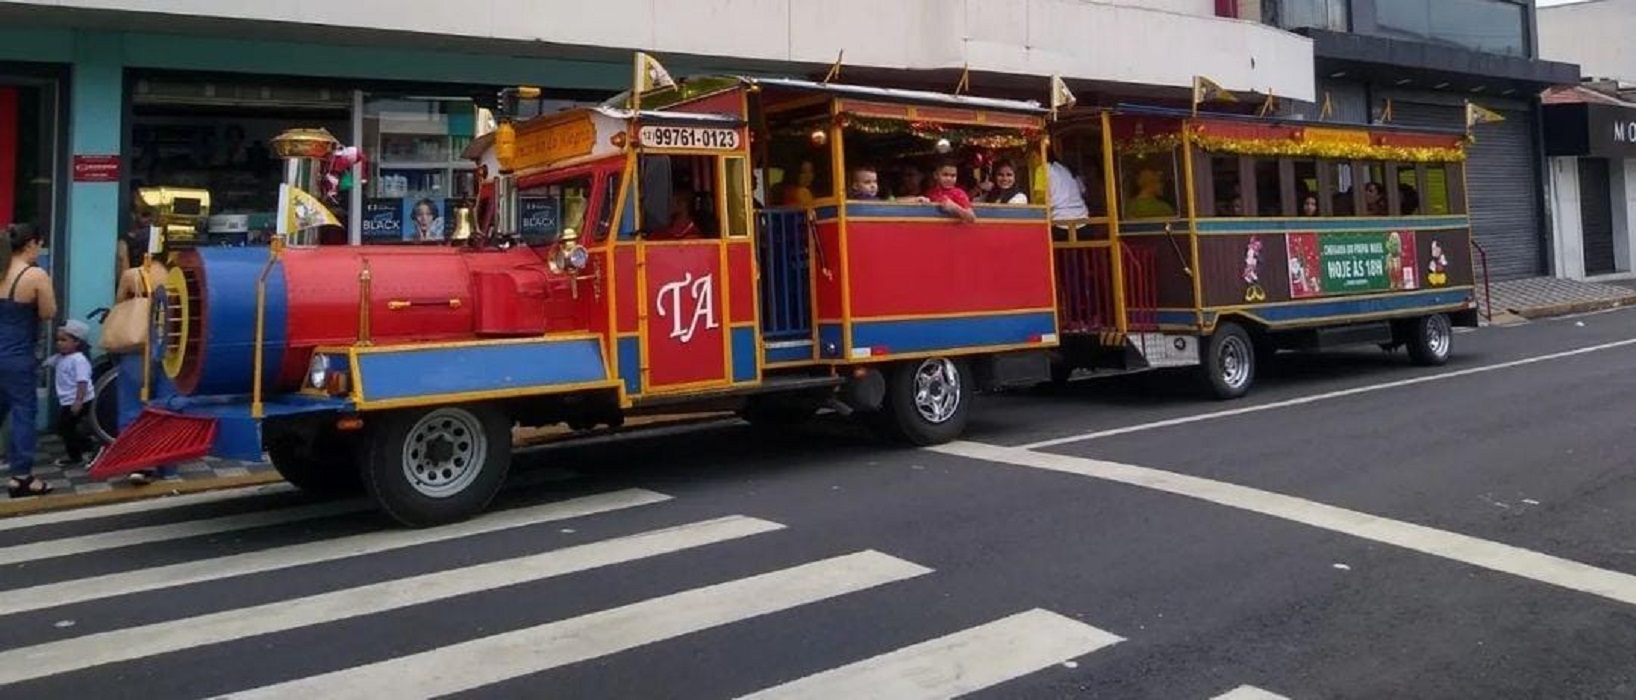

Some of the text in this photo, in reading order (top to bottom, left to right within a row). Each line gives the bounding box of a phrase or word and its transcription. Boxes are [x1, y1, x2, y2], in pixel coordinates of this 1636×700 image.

[363, 219, 400, 230] BLACK
[1328, 259, 1352, 279] HOJE
[1365, 258, 1383, 277] 18H
[656, 271, 719, 342] TA
